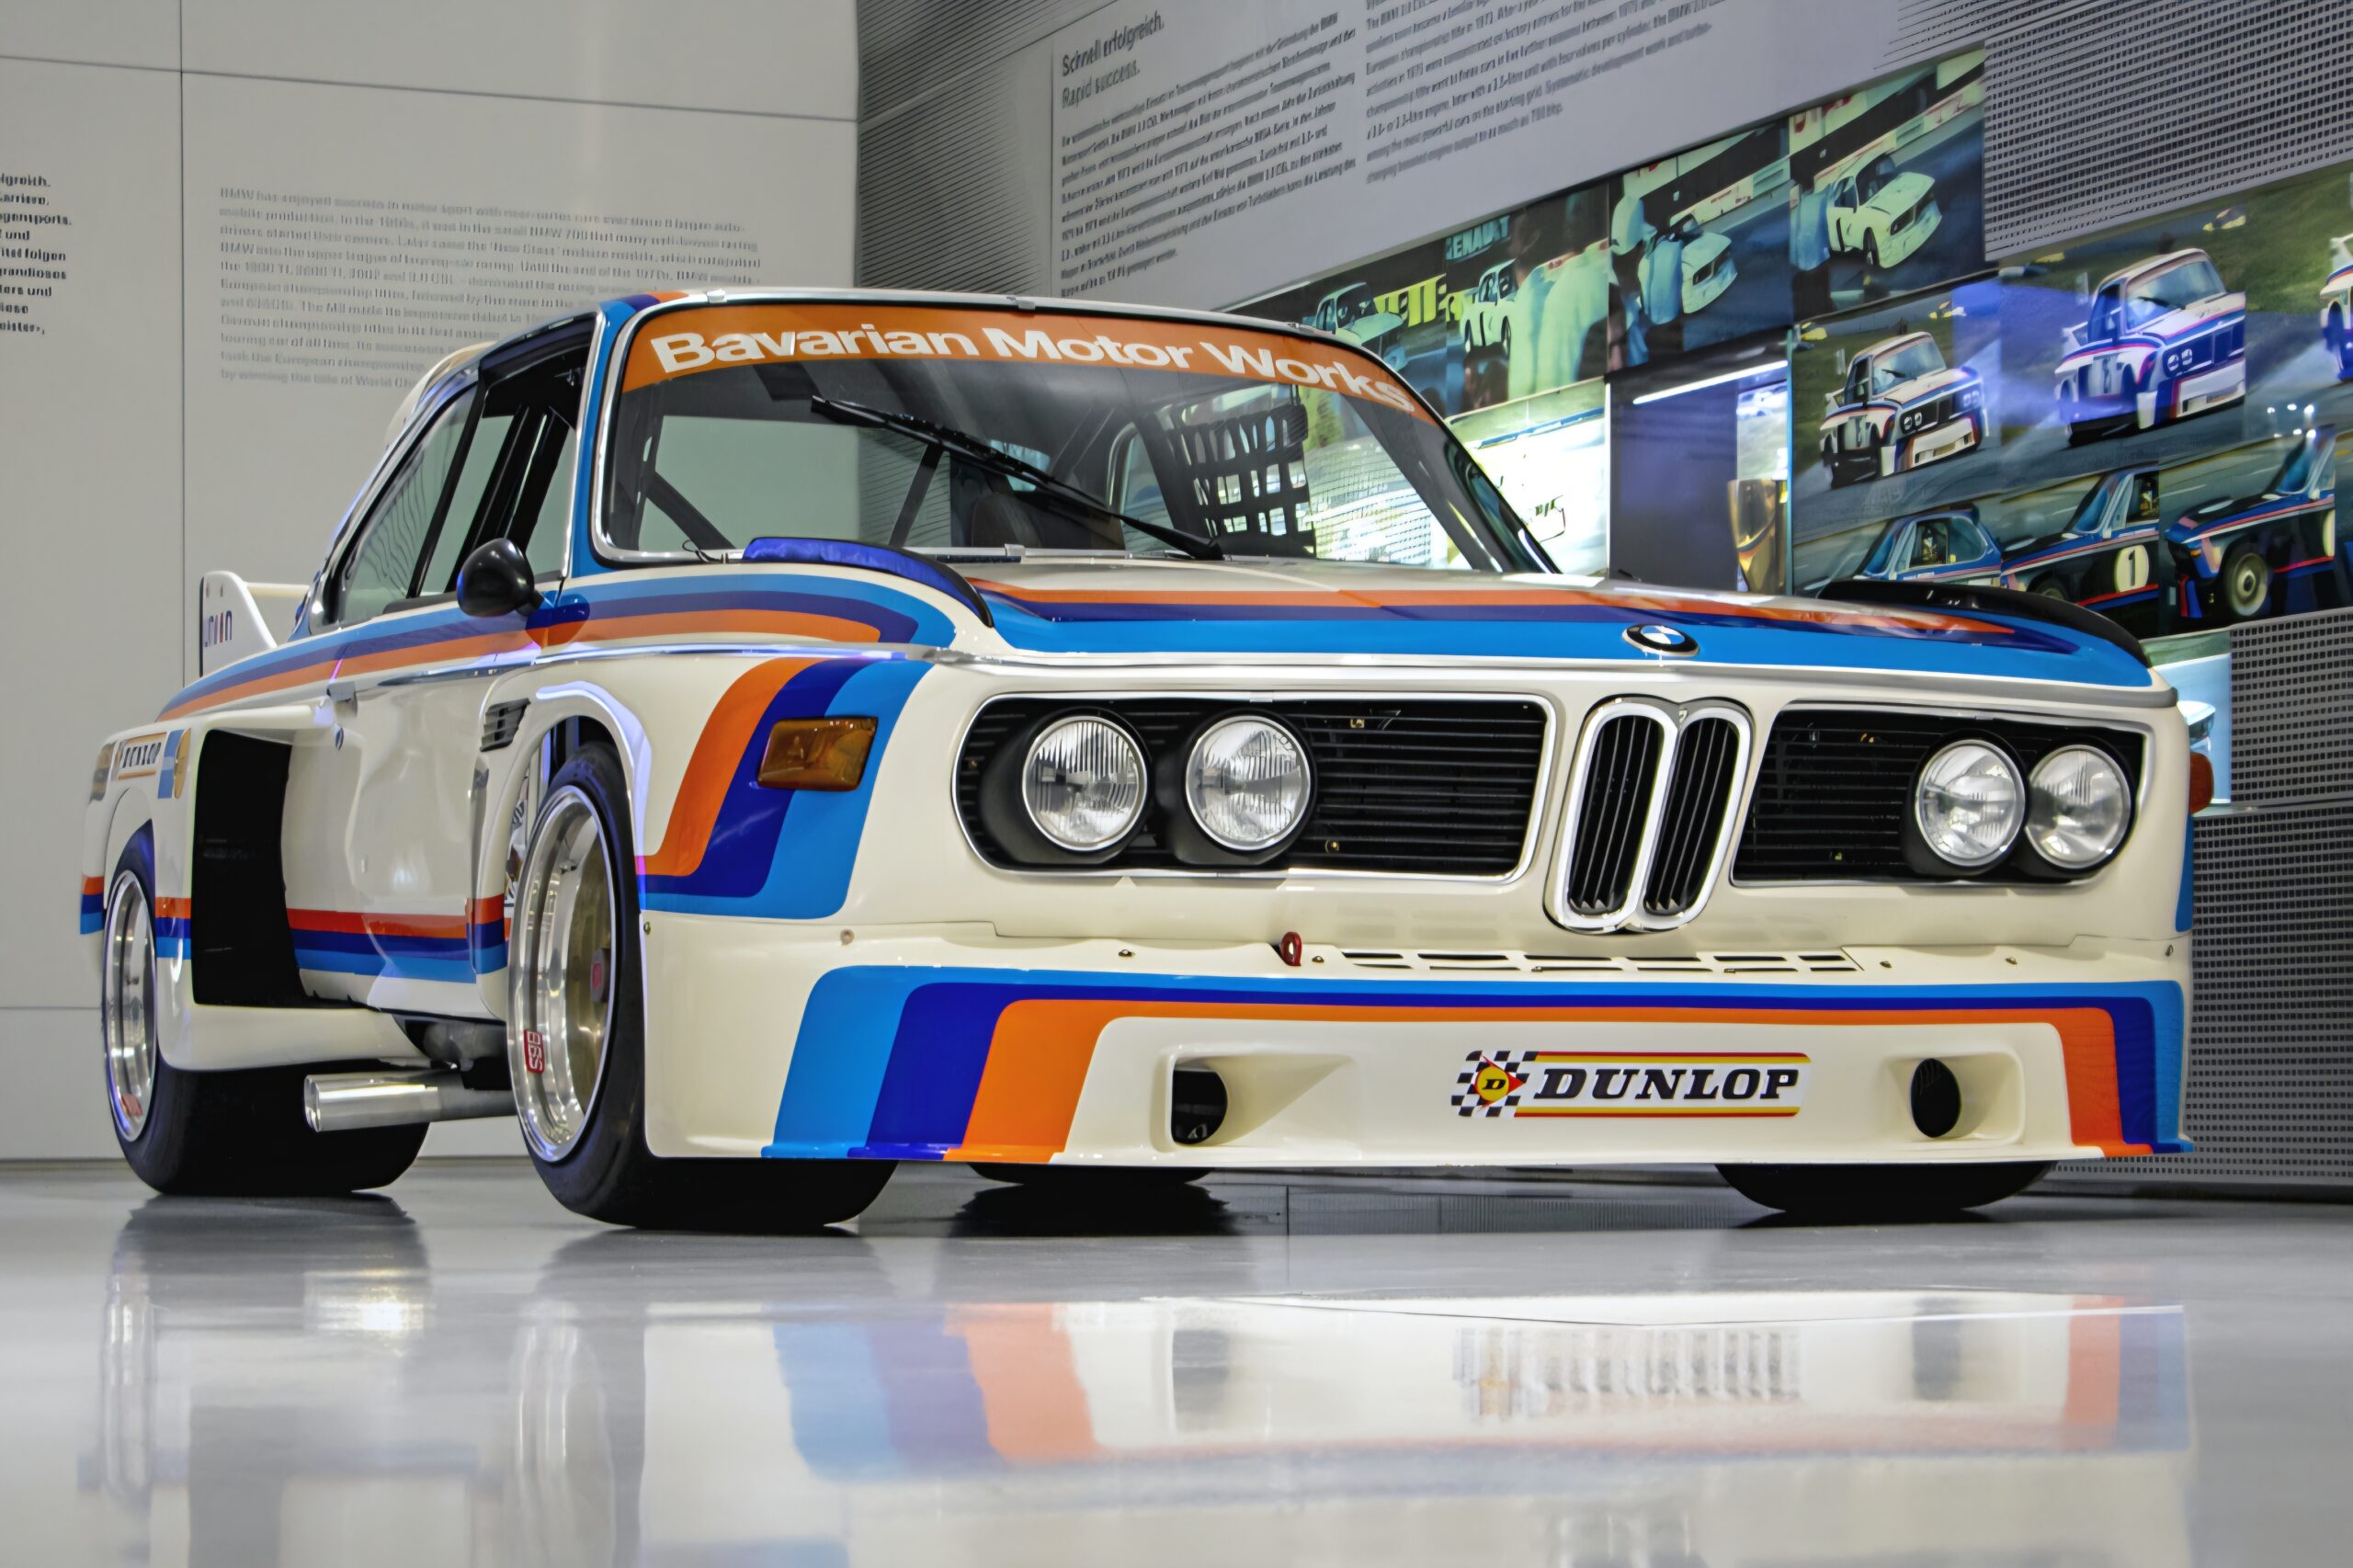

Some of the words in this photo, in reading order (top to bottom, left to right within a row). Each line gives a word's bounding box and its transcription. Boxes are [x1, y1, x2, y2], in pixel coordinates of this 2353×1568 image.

[1062, 39, 1101, 77] Schnell
[1102, 10, 1165, 57] erfolgreich.
[650, 323, 980, 374] Bavarian
[982, 326, 1195, 369] Motor
[1198, 341, 1416, 414] Works
[1482, 1077, 1506, 1091] D
[1532, 1068, 1800, 1100] DUNLOP
